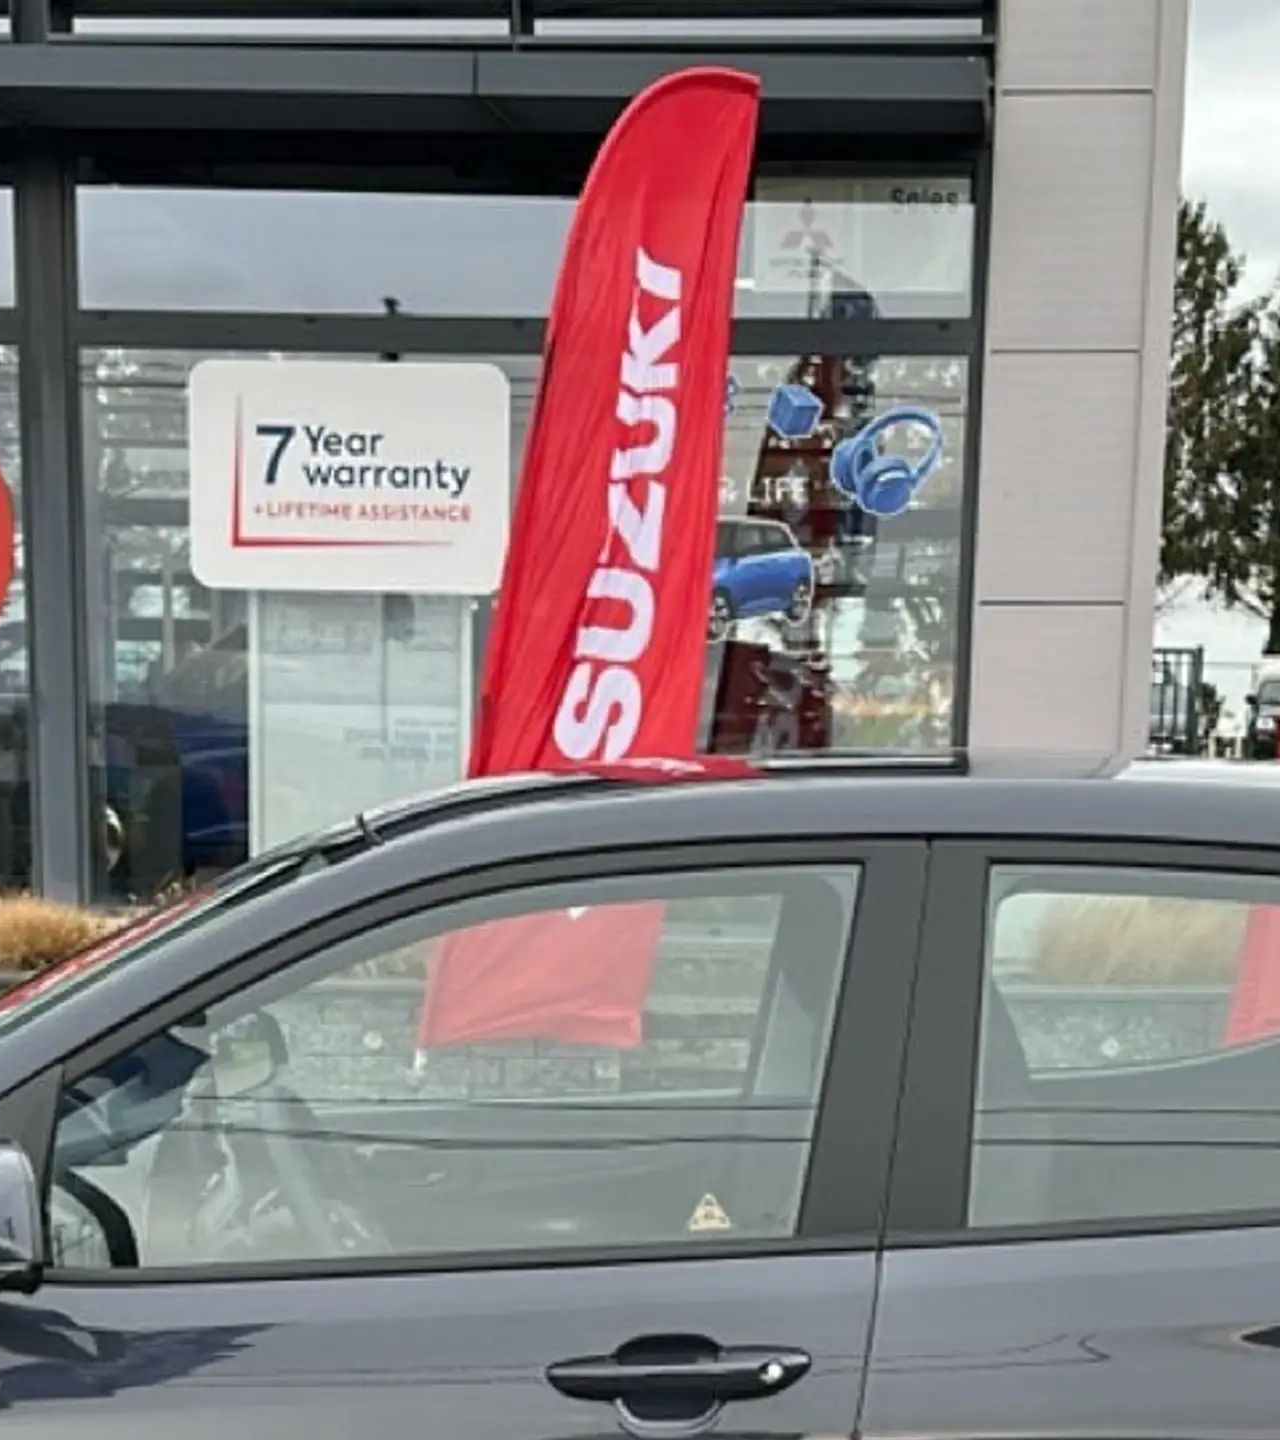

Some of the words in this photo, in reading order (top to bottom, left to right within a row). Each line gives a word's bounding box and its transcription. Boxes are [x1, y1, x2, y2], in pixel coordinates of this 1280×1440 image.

[256, 425, 297, 486] 7
[303, 425, 384, 457] Year
[302, 459, 471, 498] warranty
[359, 503, 472, 522] ASSISTANCE
[553, 247, 684, 760] SUZUKI
